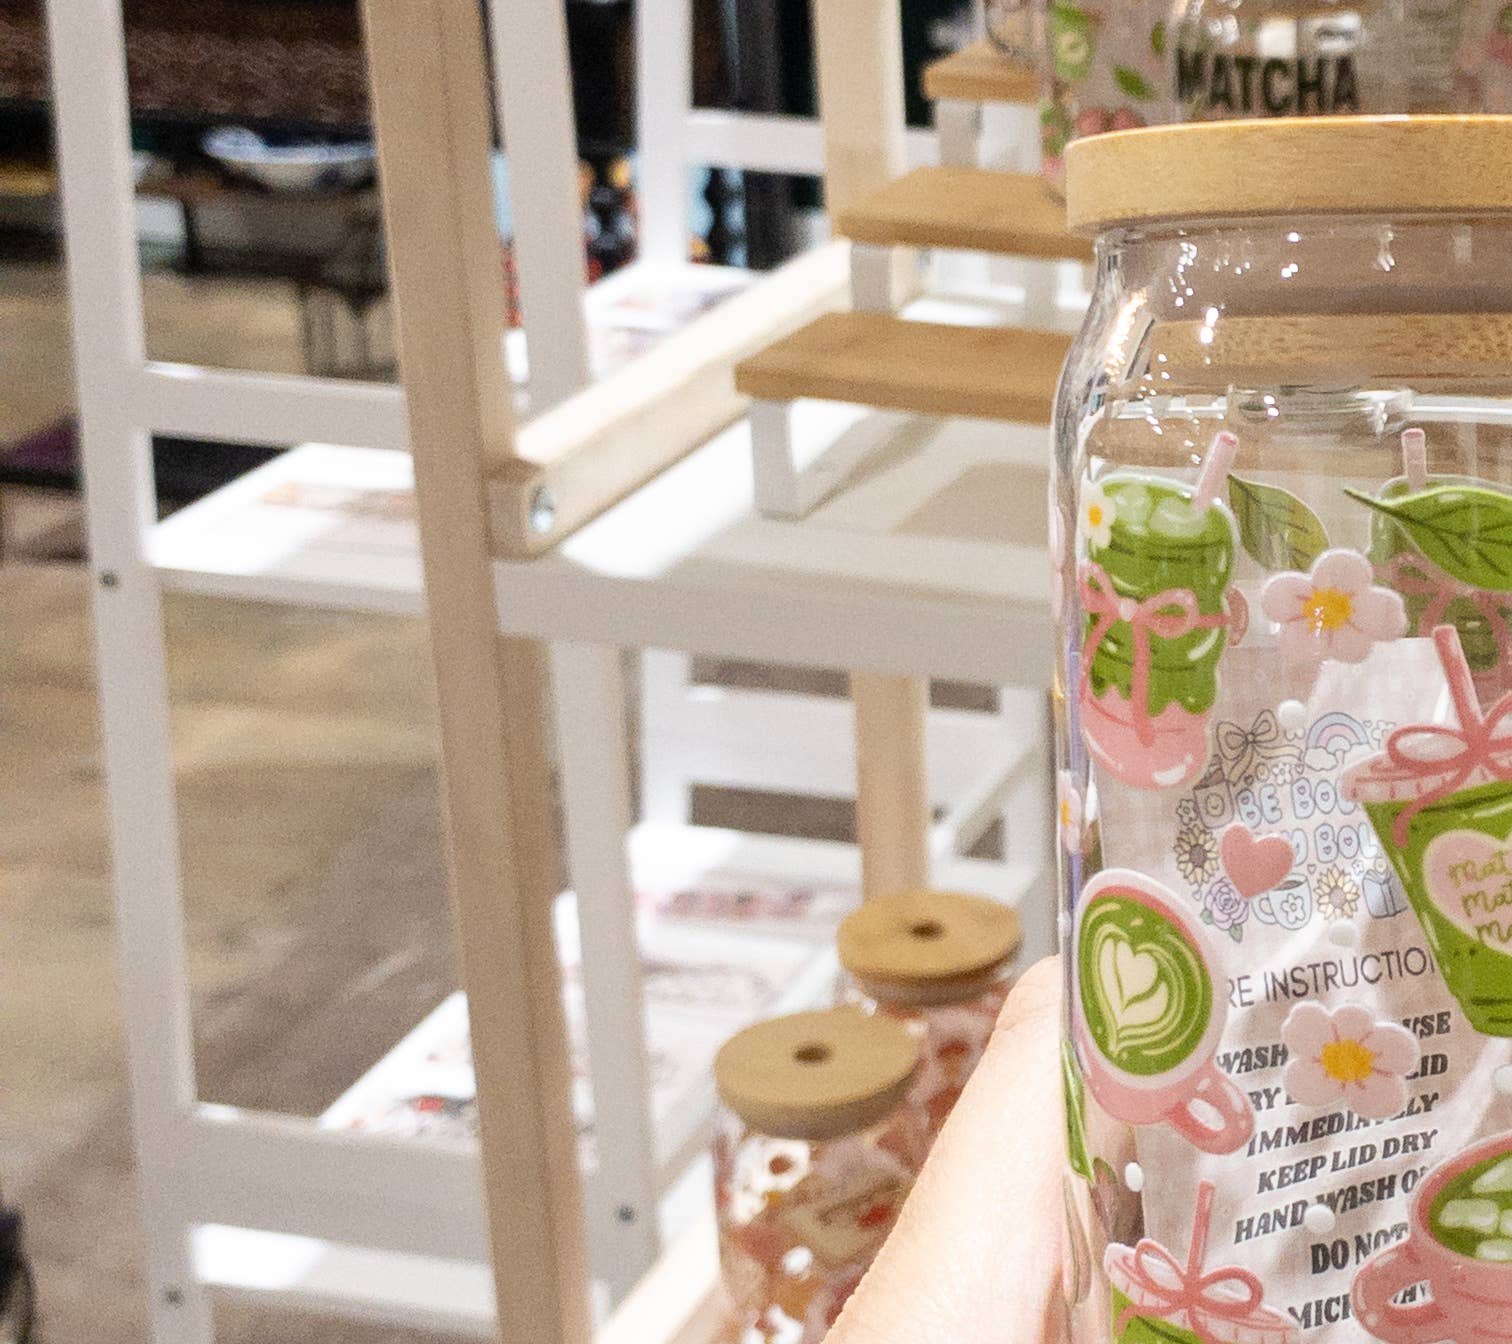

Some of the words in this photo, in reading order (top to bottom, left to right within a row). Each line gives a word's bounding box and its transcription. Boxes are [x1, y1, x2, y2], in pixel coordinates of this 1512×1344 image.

[1173, 47, 1360, 113] MATCHA
[1235, 783, 1283, 828] BE
[1291, 777, 1358, 820] BOL
[1314, 822, 1383, 864] BOL
[1263, 947, 1436, 1002] INSTRUCTIO
[1217, 1043, 1290, 1075] WASH
[1246, 1092, 1439, 1158] IMMEDIALY
[1247, 1087, 1281, 1111] RY
[1257, 1154, 1328, 1194] KEEP
[1331, 1144, 1377, 1172] LID
[1382, 1129, 1439, 1160] DRY
[1234, 1199, 1309, 1244] HAND
[1316, 1174, 1397, 1214] WASH
[1311, 1238, 1350, 1275] DO
